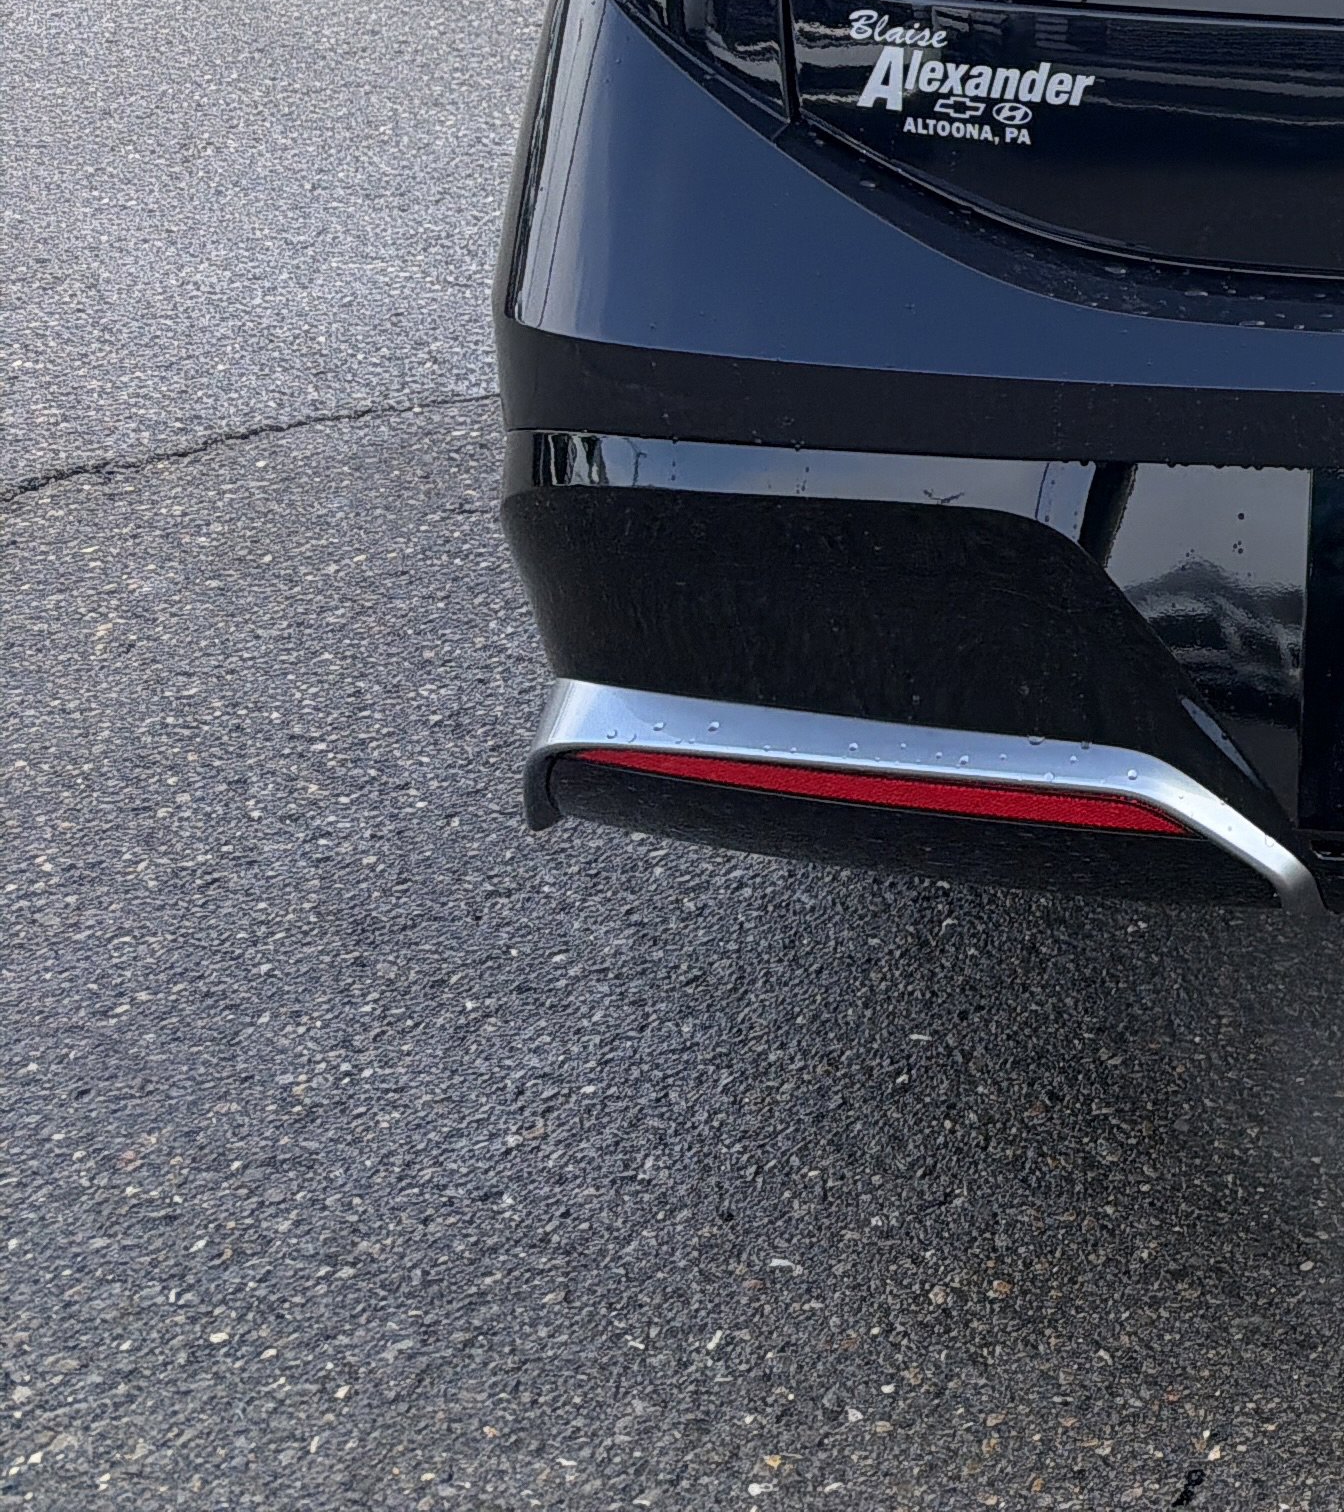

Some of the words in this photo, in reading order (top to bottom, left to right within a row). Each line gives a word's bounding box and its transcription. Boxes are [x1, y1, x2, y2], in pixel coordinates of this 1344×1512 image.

[849, 9, 948, 48] Blaise
[857, 45, 1095, 111] Alexander
[903, 116, 1000, 145] ALTOONA,
[1005, 127, 1032, 145] PA
